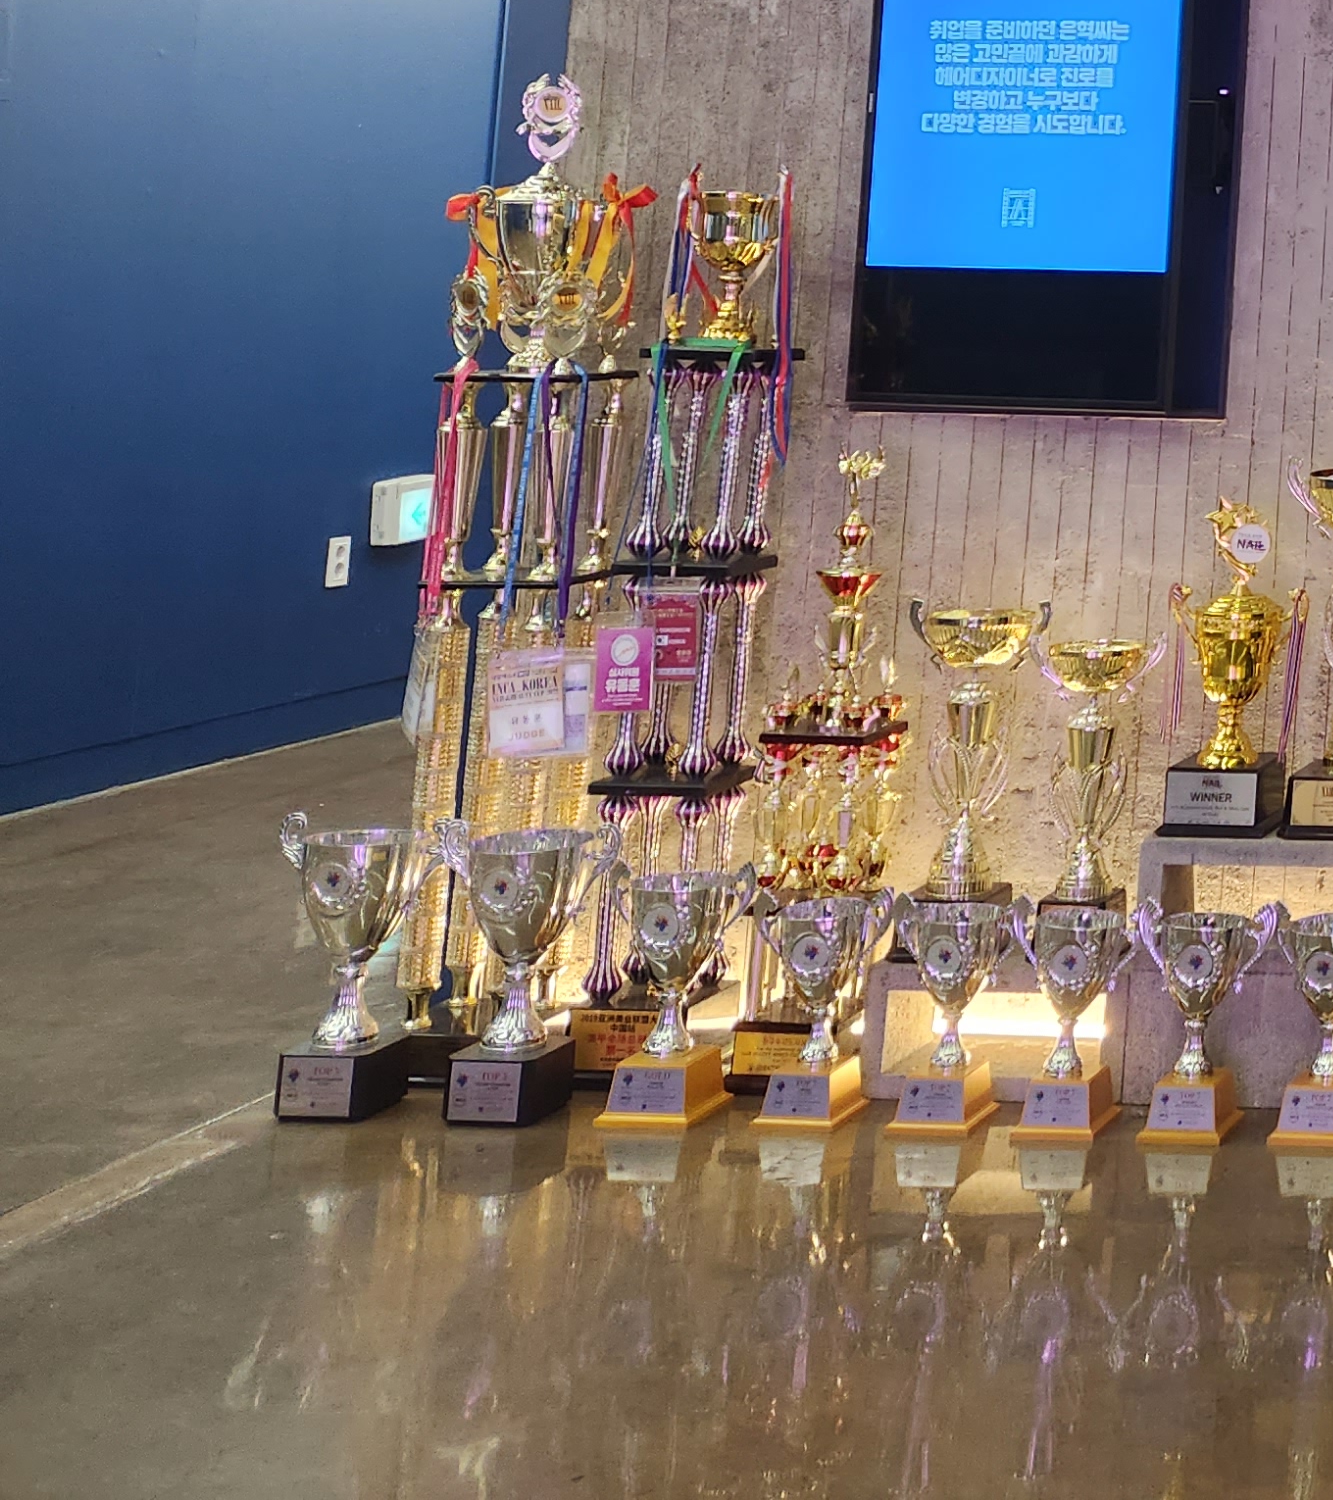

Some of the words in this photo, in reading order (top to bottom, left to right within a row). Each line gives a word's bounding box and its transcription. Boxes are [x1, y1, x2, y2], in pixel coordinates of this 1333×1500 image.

[929, 20, 982, 40] 취업을
[986, 20, 1056, 40] 준비하던
[1060, 20, 1130, 41] 은혁씨는
[934, 43, 970, 63] 많은
[973, 43, 1043, 64] 고민끝에
[1046, 44, 1118, 64] 과감하게
[935, 67, 1057, 87] 헤어디자이너로
[1060, 67, 1114, 88] 진로를
[953, 90, 1023, 110] 변경하고
[1026, 90, 1098, 111] 누구보다
[921, 113, 975, 133] 다양한
[977, 113, 1031, 134] 경험을
[1033, 114, 1127, 135] 시도합니다.
[510, 728, 545, 741] JUDGE
[1190, 790, 1232, 803] WINNER
